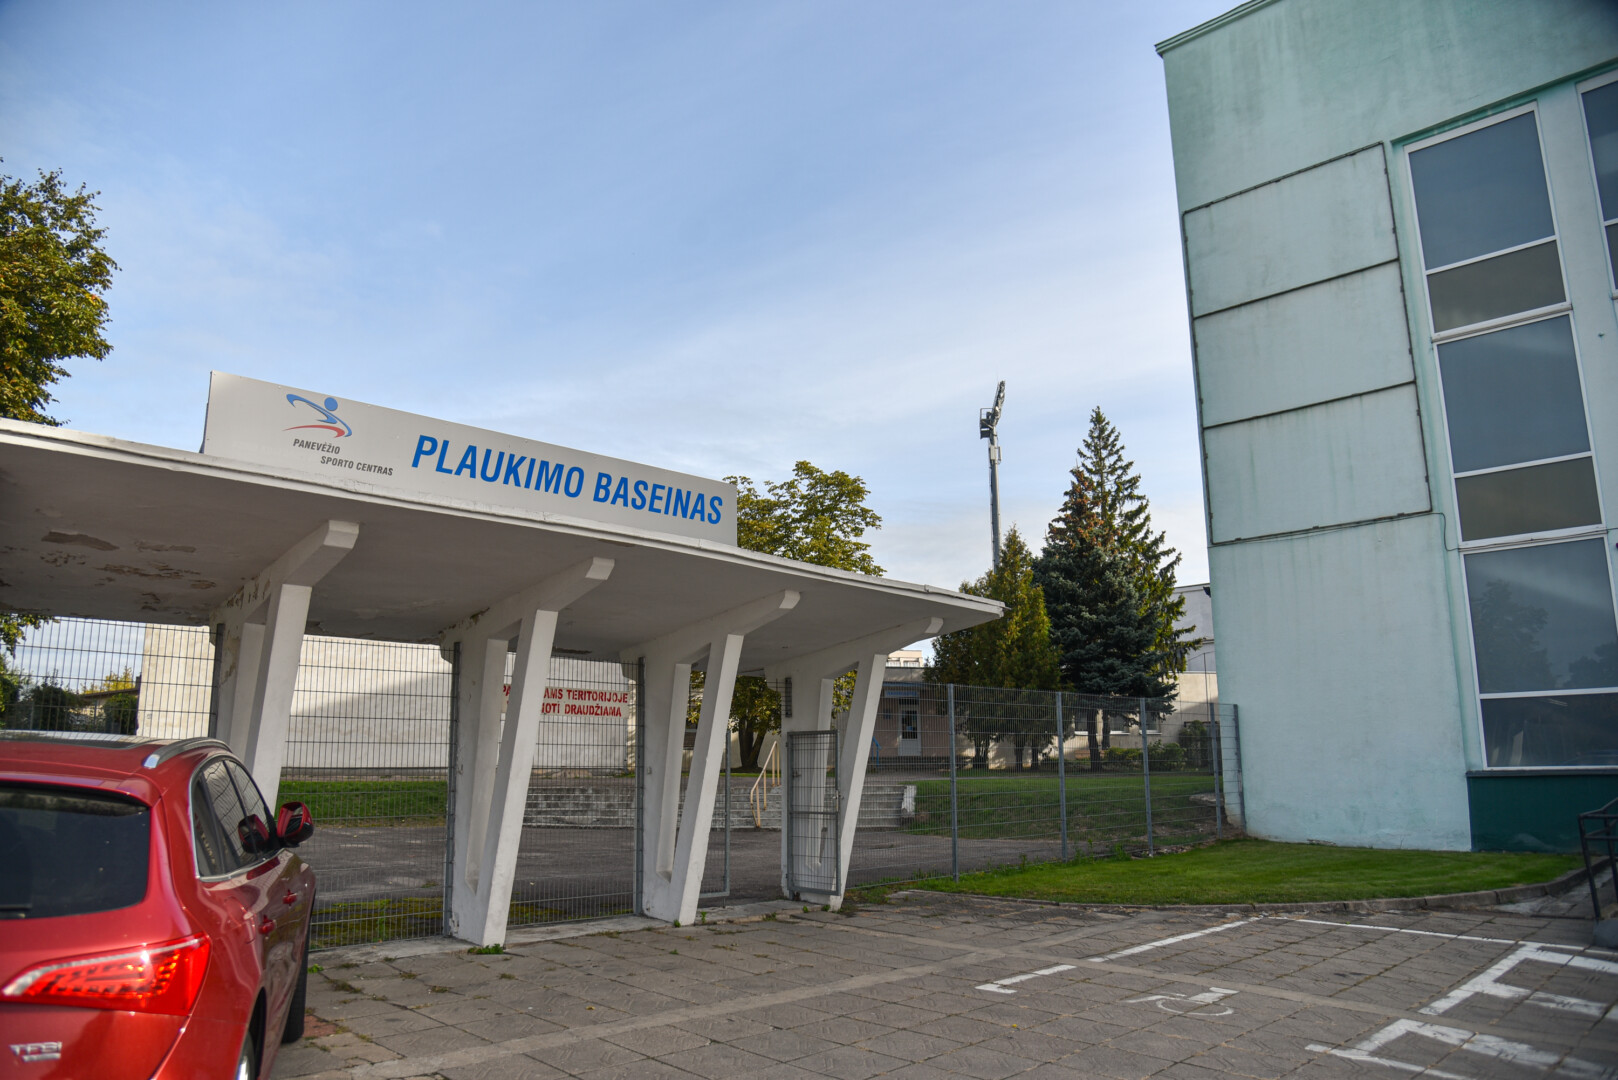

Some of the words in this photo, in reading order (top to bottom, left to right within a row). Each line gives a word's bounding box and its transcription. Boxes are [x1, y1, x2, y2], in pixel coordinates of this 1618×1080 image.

[293, 438, 341, 455] PANEVĖŽIO
[320, 455, 354, 470] SPORTO
[356, 462, 393, 476] CENTRAS
[411, 434, 585, 498] PLAUKIMO
[593, 472, 723, 525] BASEINAS
[566, 689, 629, 703] TERITORIJOJE
[564, 703, 622, 717] DRAUDŽIAMA
